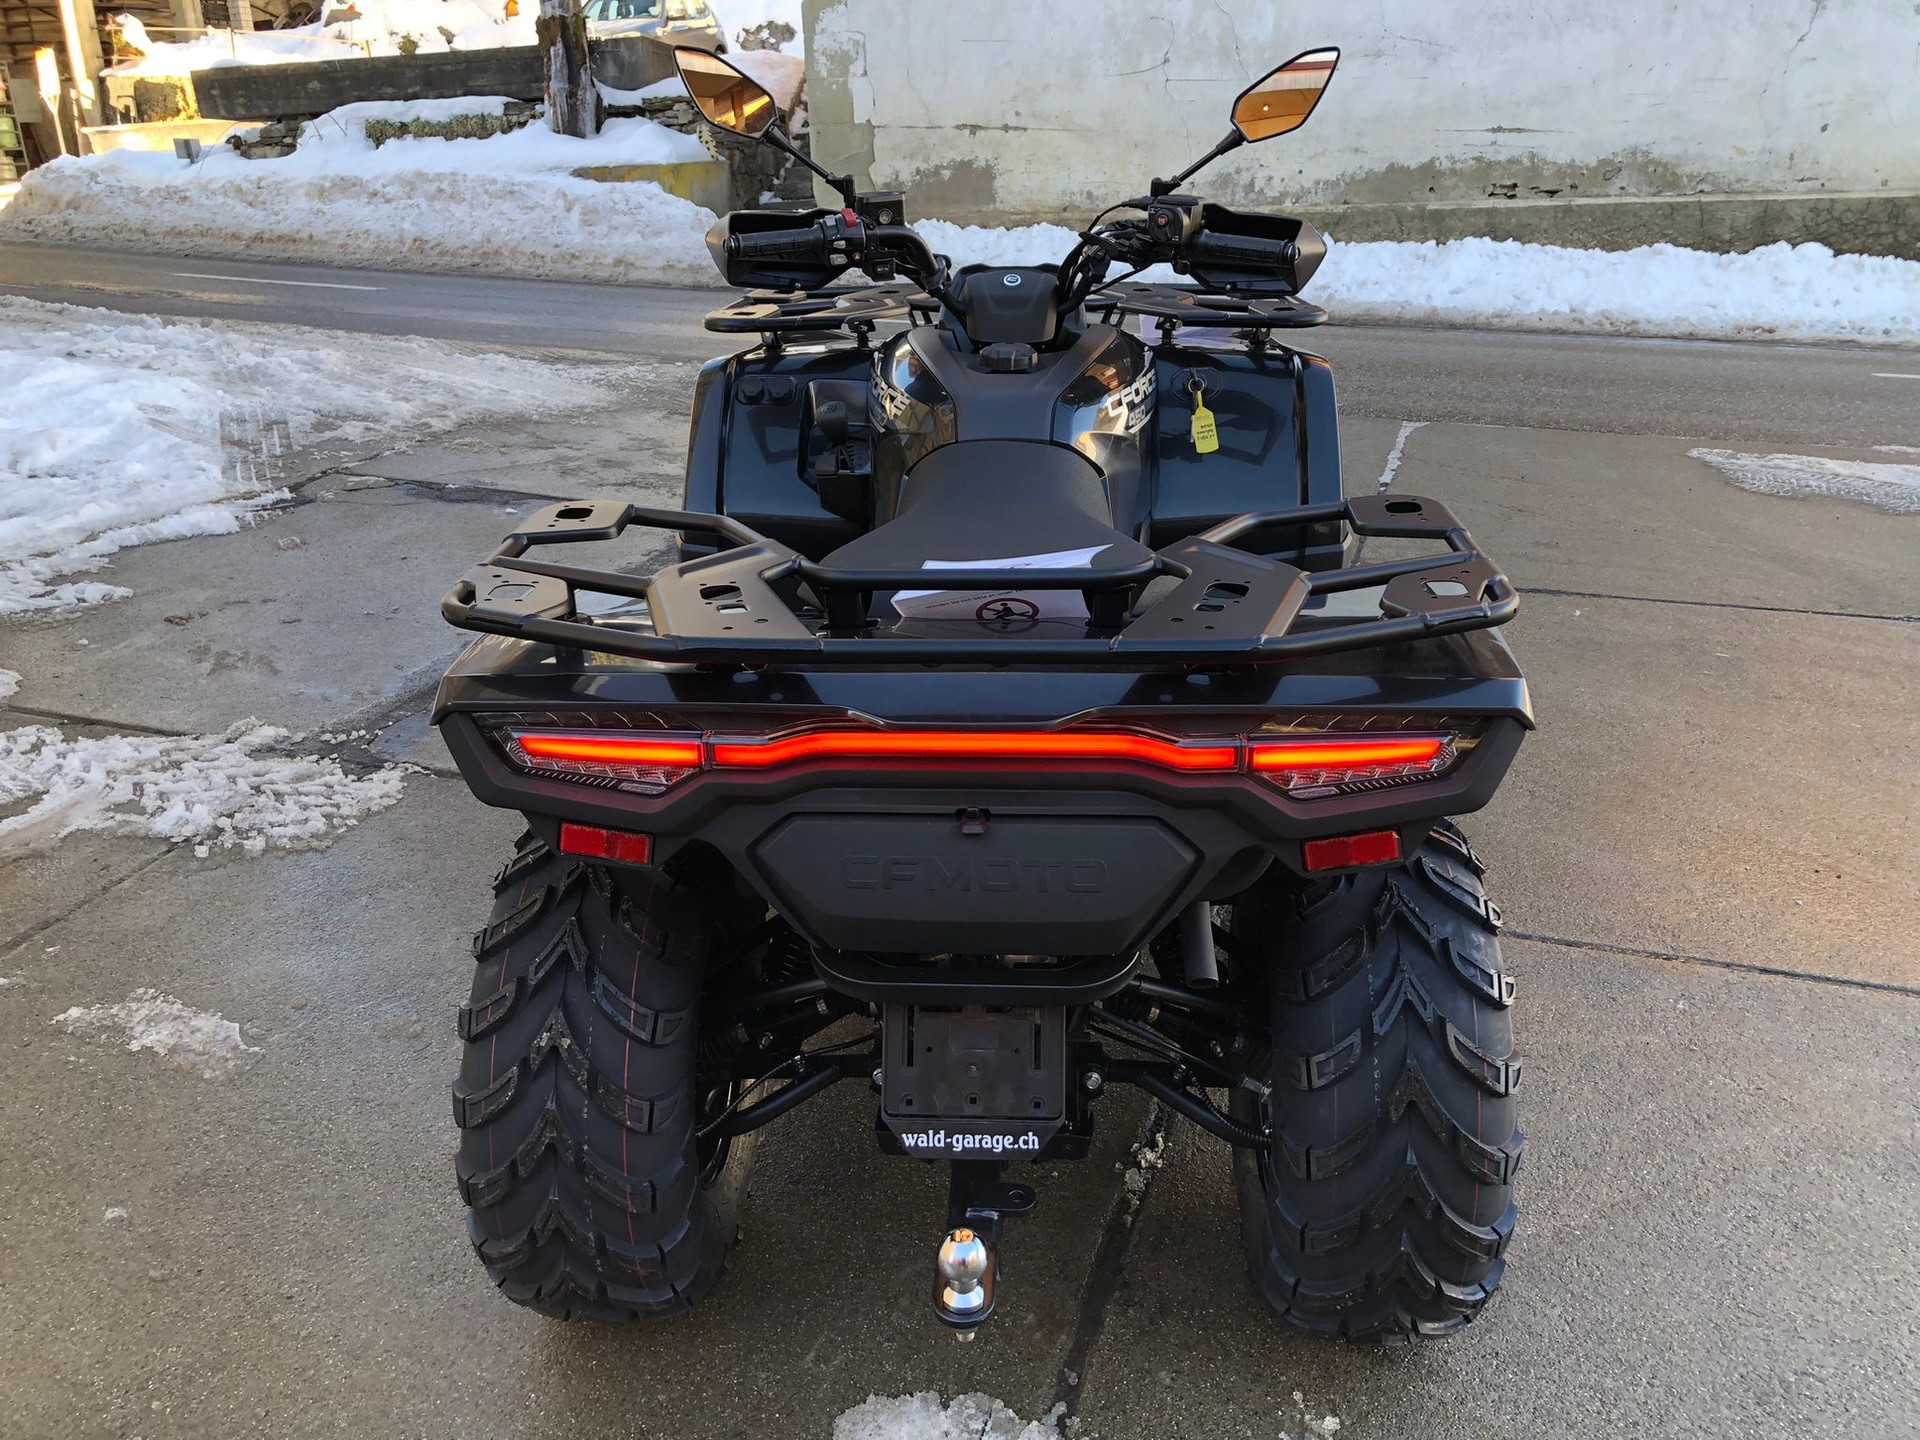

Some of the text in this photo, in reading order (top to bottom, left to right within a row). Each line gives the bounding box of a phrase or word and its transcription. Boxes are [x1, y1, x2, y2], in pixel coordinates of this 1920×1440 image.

[871, 367, 911, 417] FORCE
[1107, 368, 1156, 417] CFORCE
[1128, 404, 1146, 428] 450
[840, 855, 1108, 893] CFMOTO
[901, 1129, 1040, 1153] wald-garage.ch
